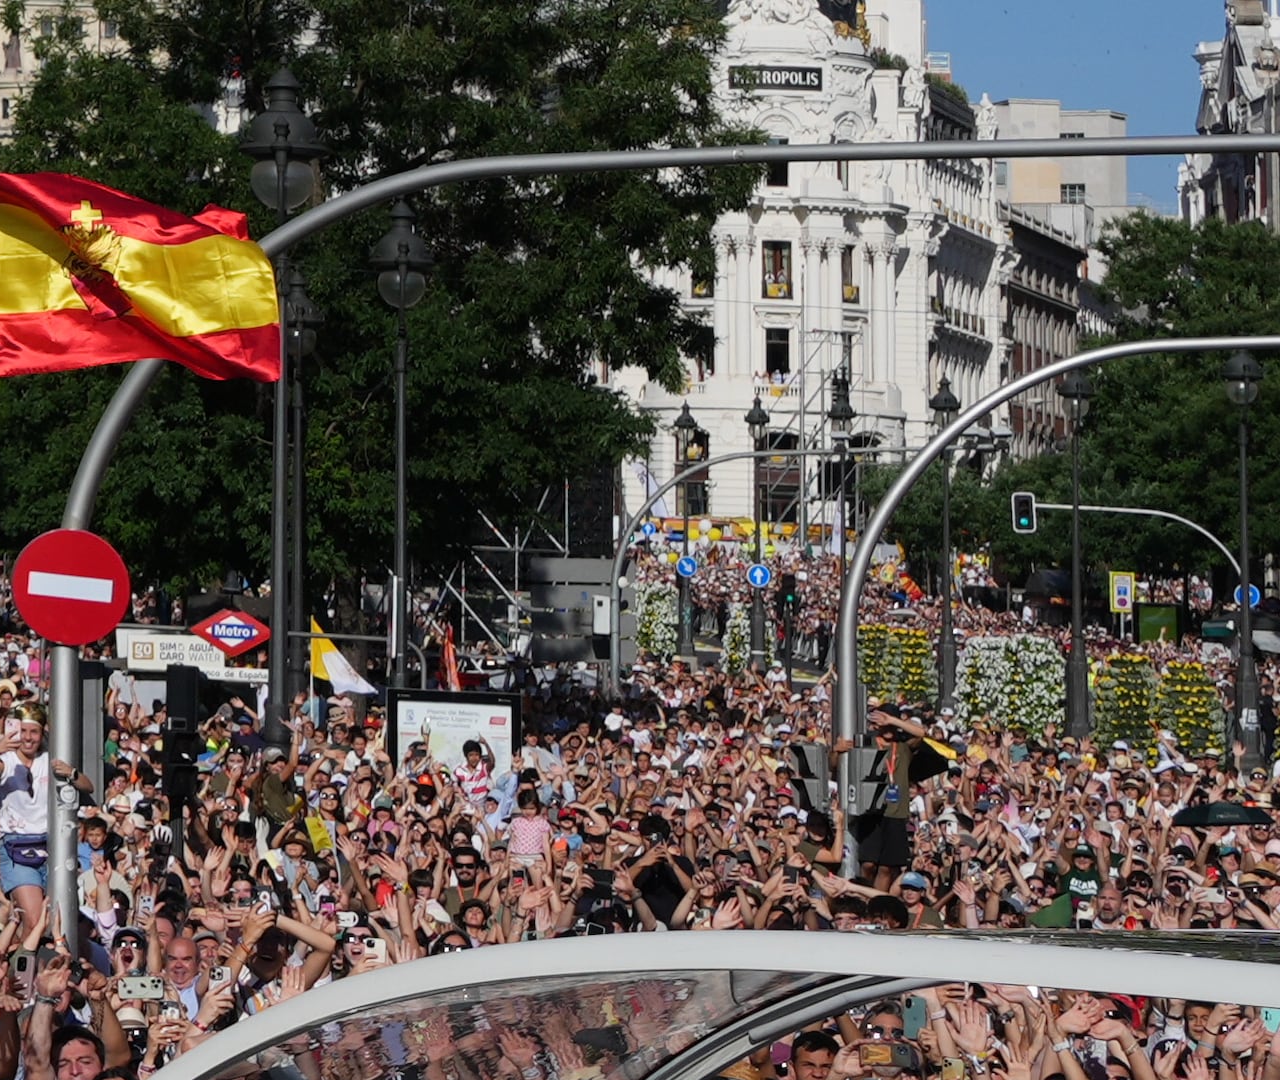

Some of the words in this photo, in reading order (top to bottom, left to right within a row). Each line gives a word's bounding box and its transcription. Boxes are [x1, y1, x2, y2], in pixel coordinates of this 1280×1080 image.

[214, 624, 250, 637] Metro
[160, 643, 176, 651] SIM
[189, 643, 214, 652] AGUA
[160, 652, 184, 661] CARD
[189, 653, 220, 662] WATER
[239, 670, 267, 679] España
